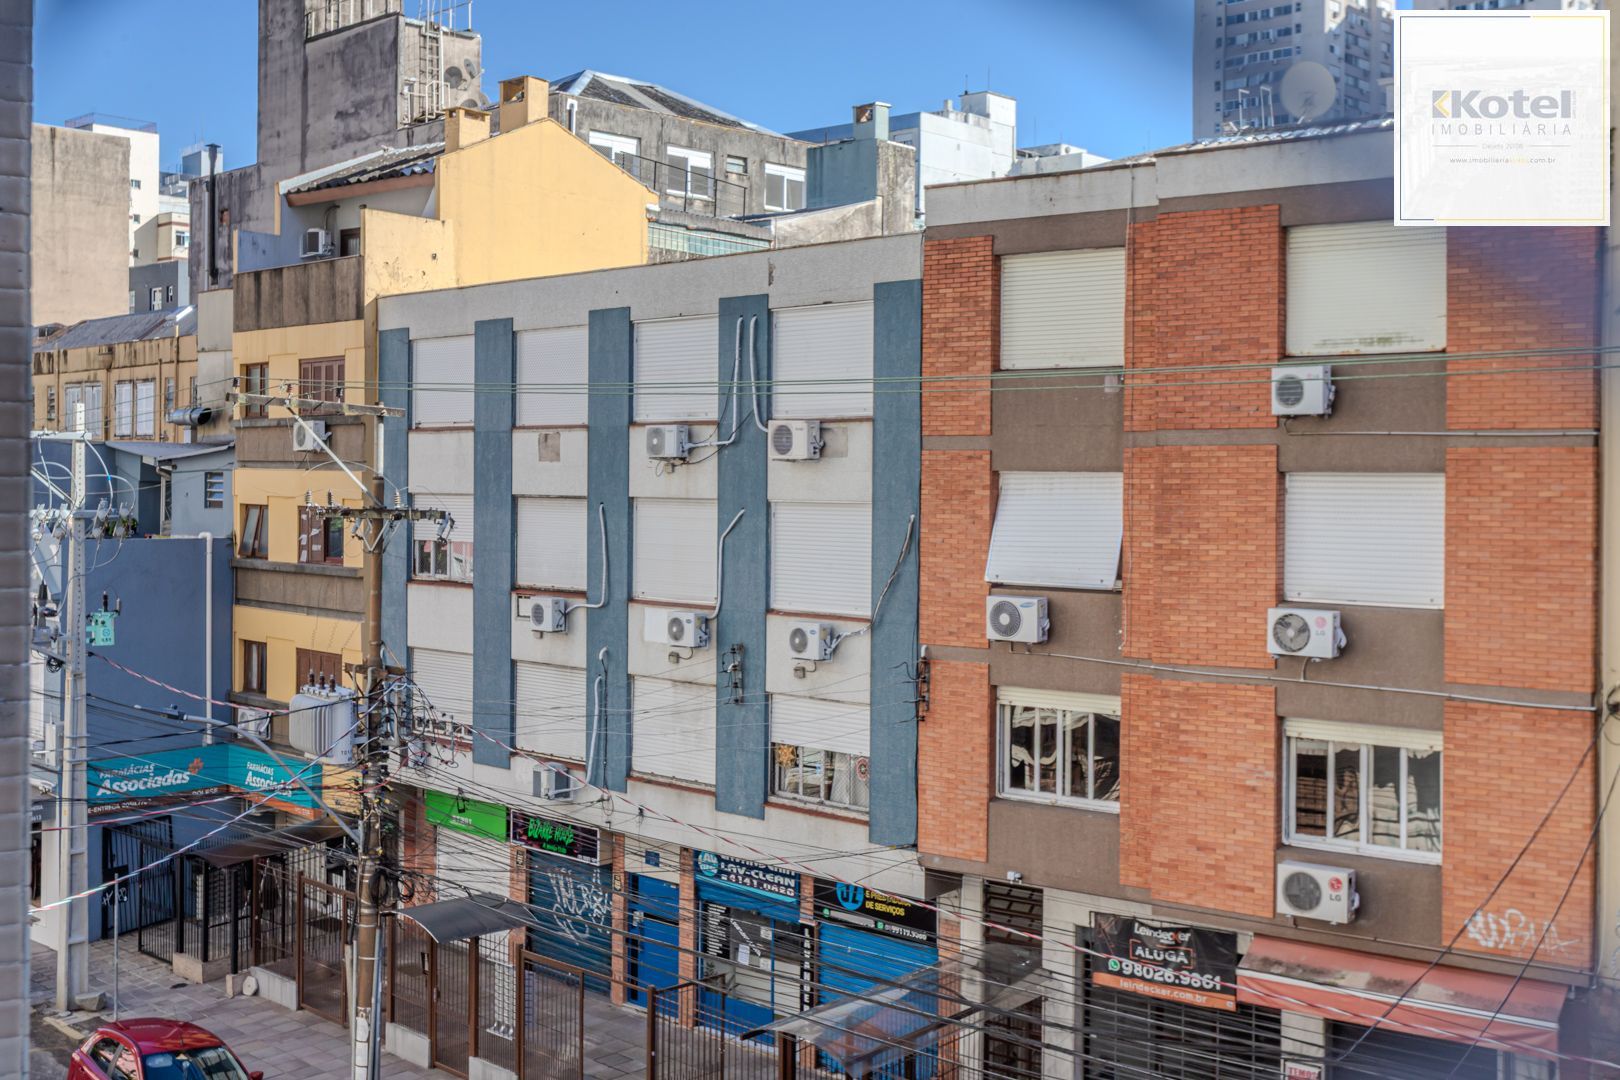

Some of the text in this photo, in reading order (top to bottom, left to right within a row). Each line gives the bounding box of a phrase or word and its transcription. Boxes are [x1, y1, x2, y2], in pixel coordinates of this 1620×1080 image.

[96, 769, 190, 796] Associadas
[720, 862, 796, 888] LAV-CLEAN
[1329, 893, 1342, 902] LG
[865, 901, 905, 917] DE SERVIÇOS
[1134, 922, 1191, 942] Leindecker
[1135, 946, 1189, 964] ALUGA
[1122, 961, 1221, 990] 98026.9861
[1119, 979, 1208, 1003] leindecker.com.br
